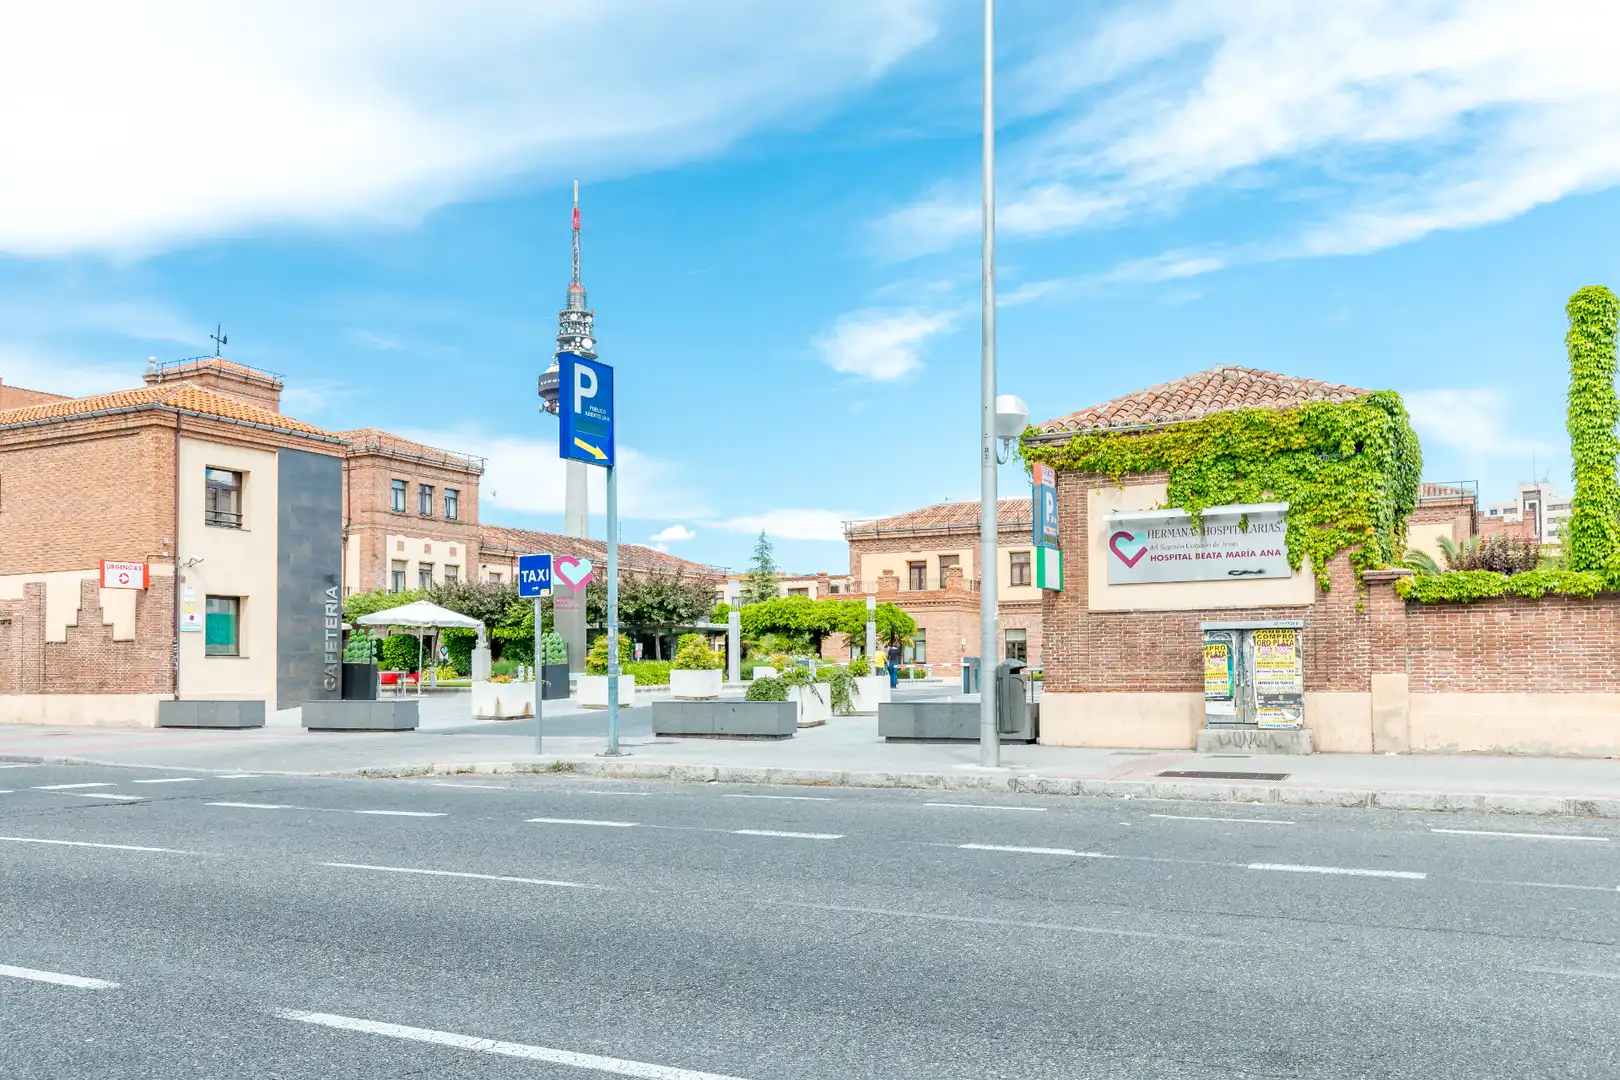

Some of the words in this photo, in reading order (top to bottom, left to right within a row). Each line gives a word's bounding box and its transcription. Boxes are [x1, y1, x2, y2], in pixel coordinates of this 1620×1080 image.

[574, 362, 598, 414] P
[1045, 491, 1054, 523] P
[1150, 553, 1192, 561] HOSPITAL
[1195, 552, 1222, 560] BEATA
[1226, 548, 1256, 558] MARÍA
[1260, 549, 1281, 557] ANA
[106, 563, 142, 571] URGENCIAS
[521, 568, 549, 583] TAXI
[324, 586, 338, 691] CAFETERIA
